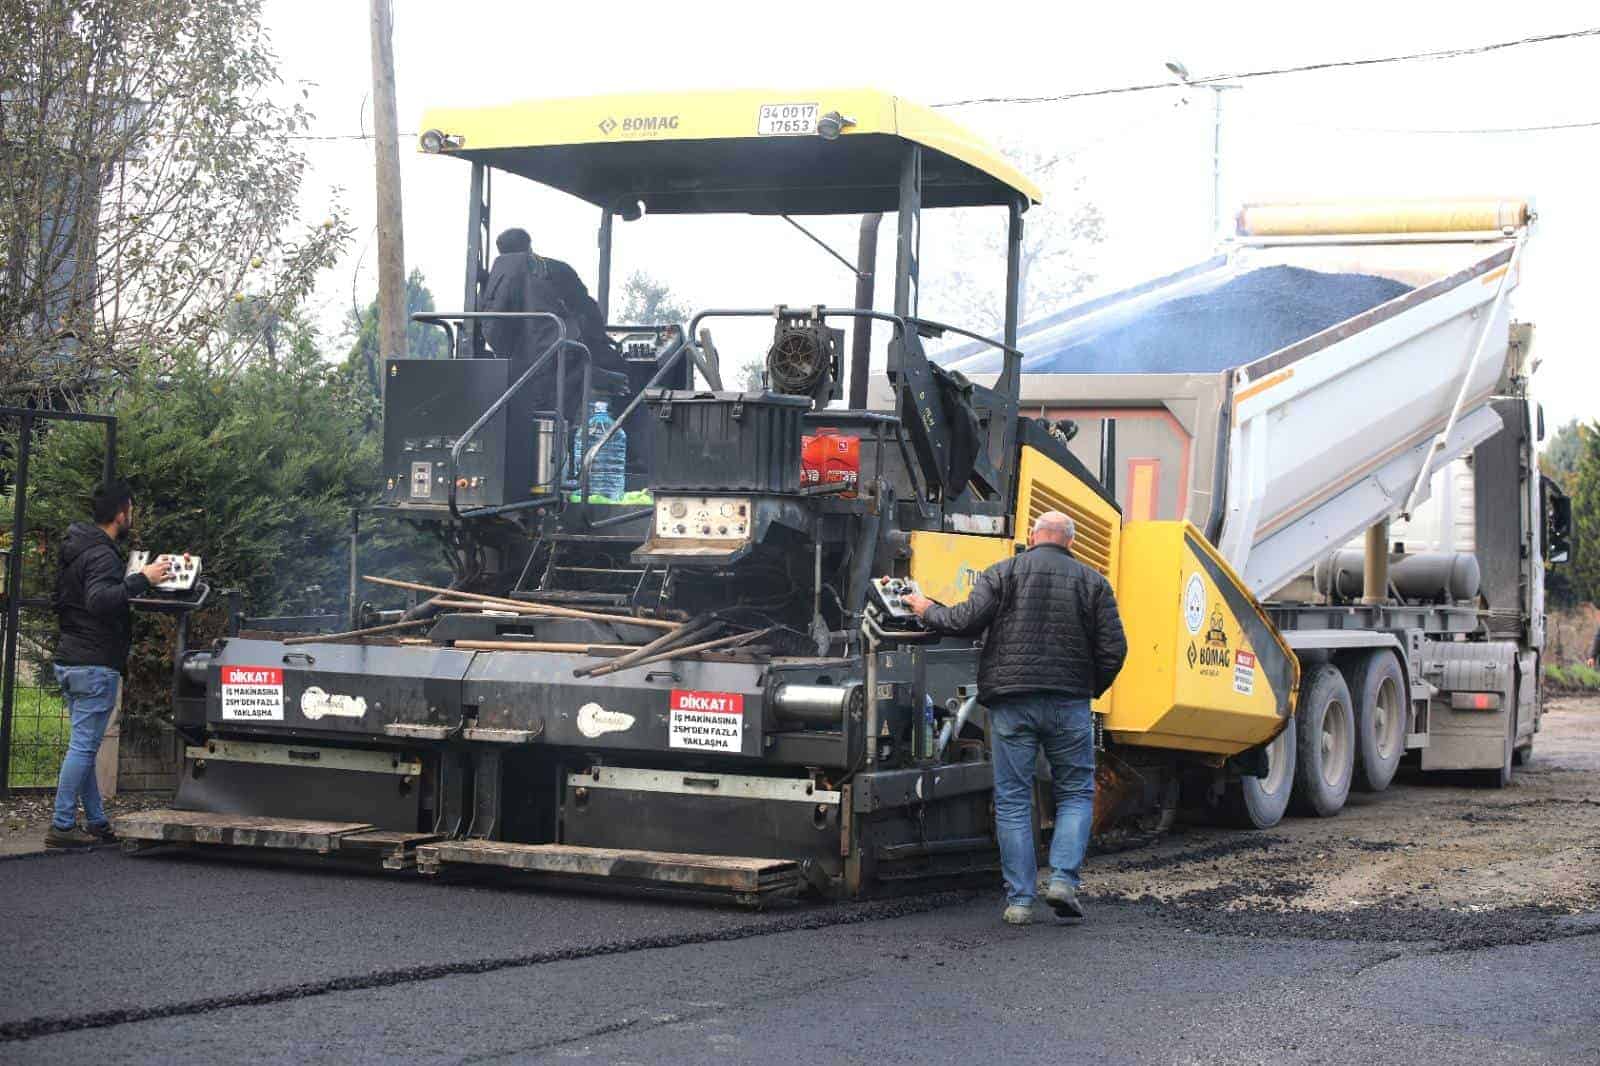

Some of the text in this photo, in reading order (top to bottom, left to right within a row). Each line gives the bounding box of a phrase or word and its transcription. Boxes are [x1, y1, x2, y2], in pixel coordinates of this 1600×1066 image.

[622, 115, 679, 131] BOMAG
[1200, 647, 1230, 668] BOMAG
[229, 669, 269, 683] DİKKAT
[679, 694, 726, 710] DİKKAT
[233, 709, 273, 718] YAKLAŞMA
[674, 711, 738, 725] İŞ MAKİNASINA
[710, 728, 738, 737] FAZLA
[682, 737, 729, 748] YAKLAŞMA
